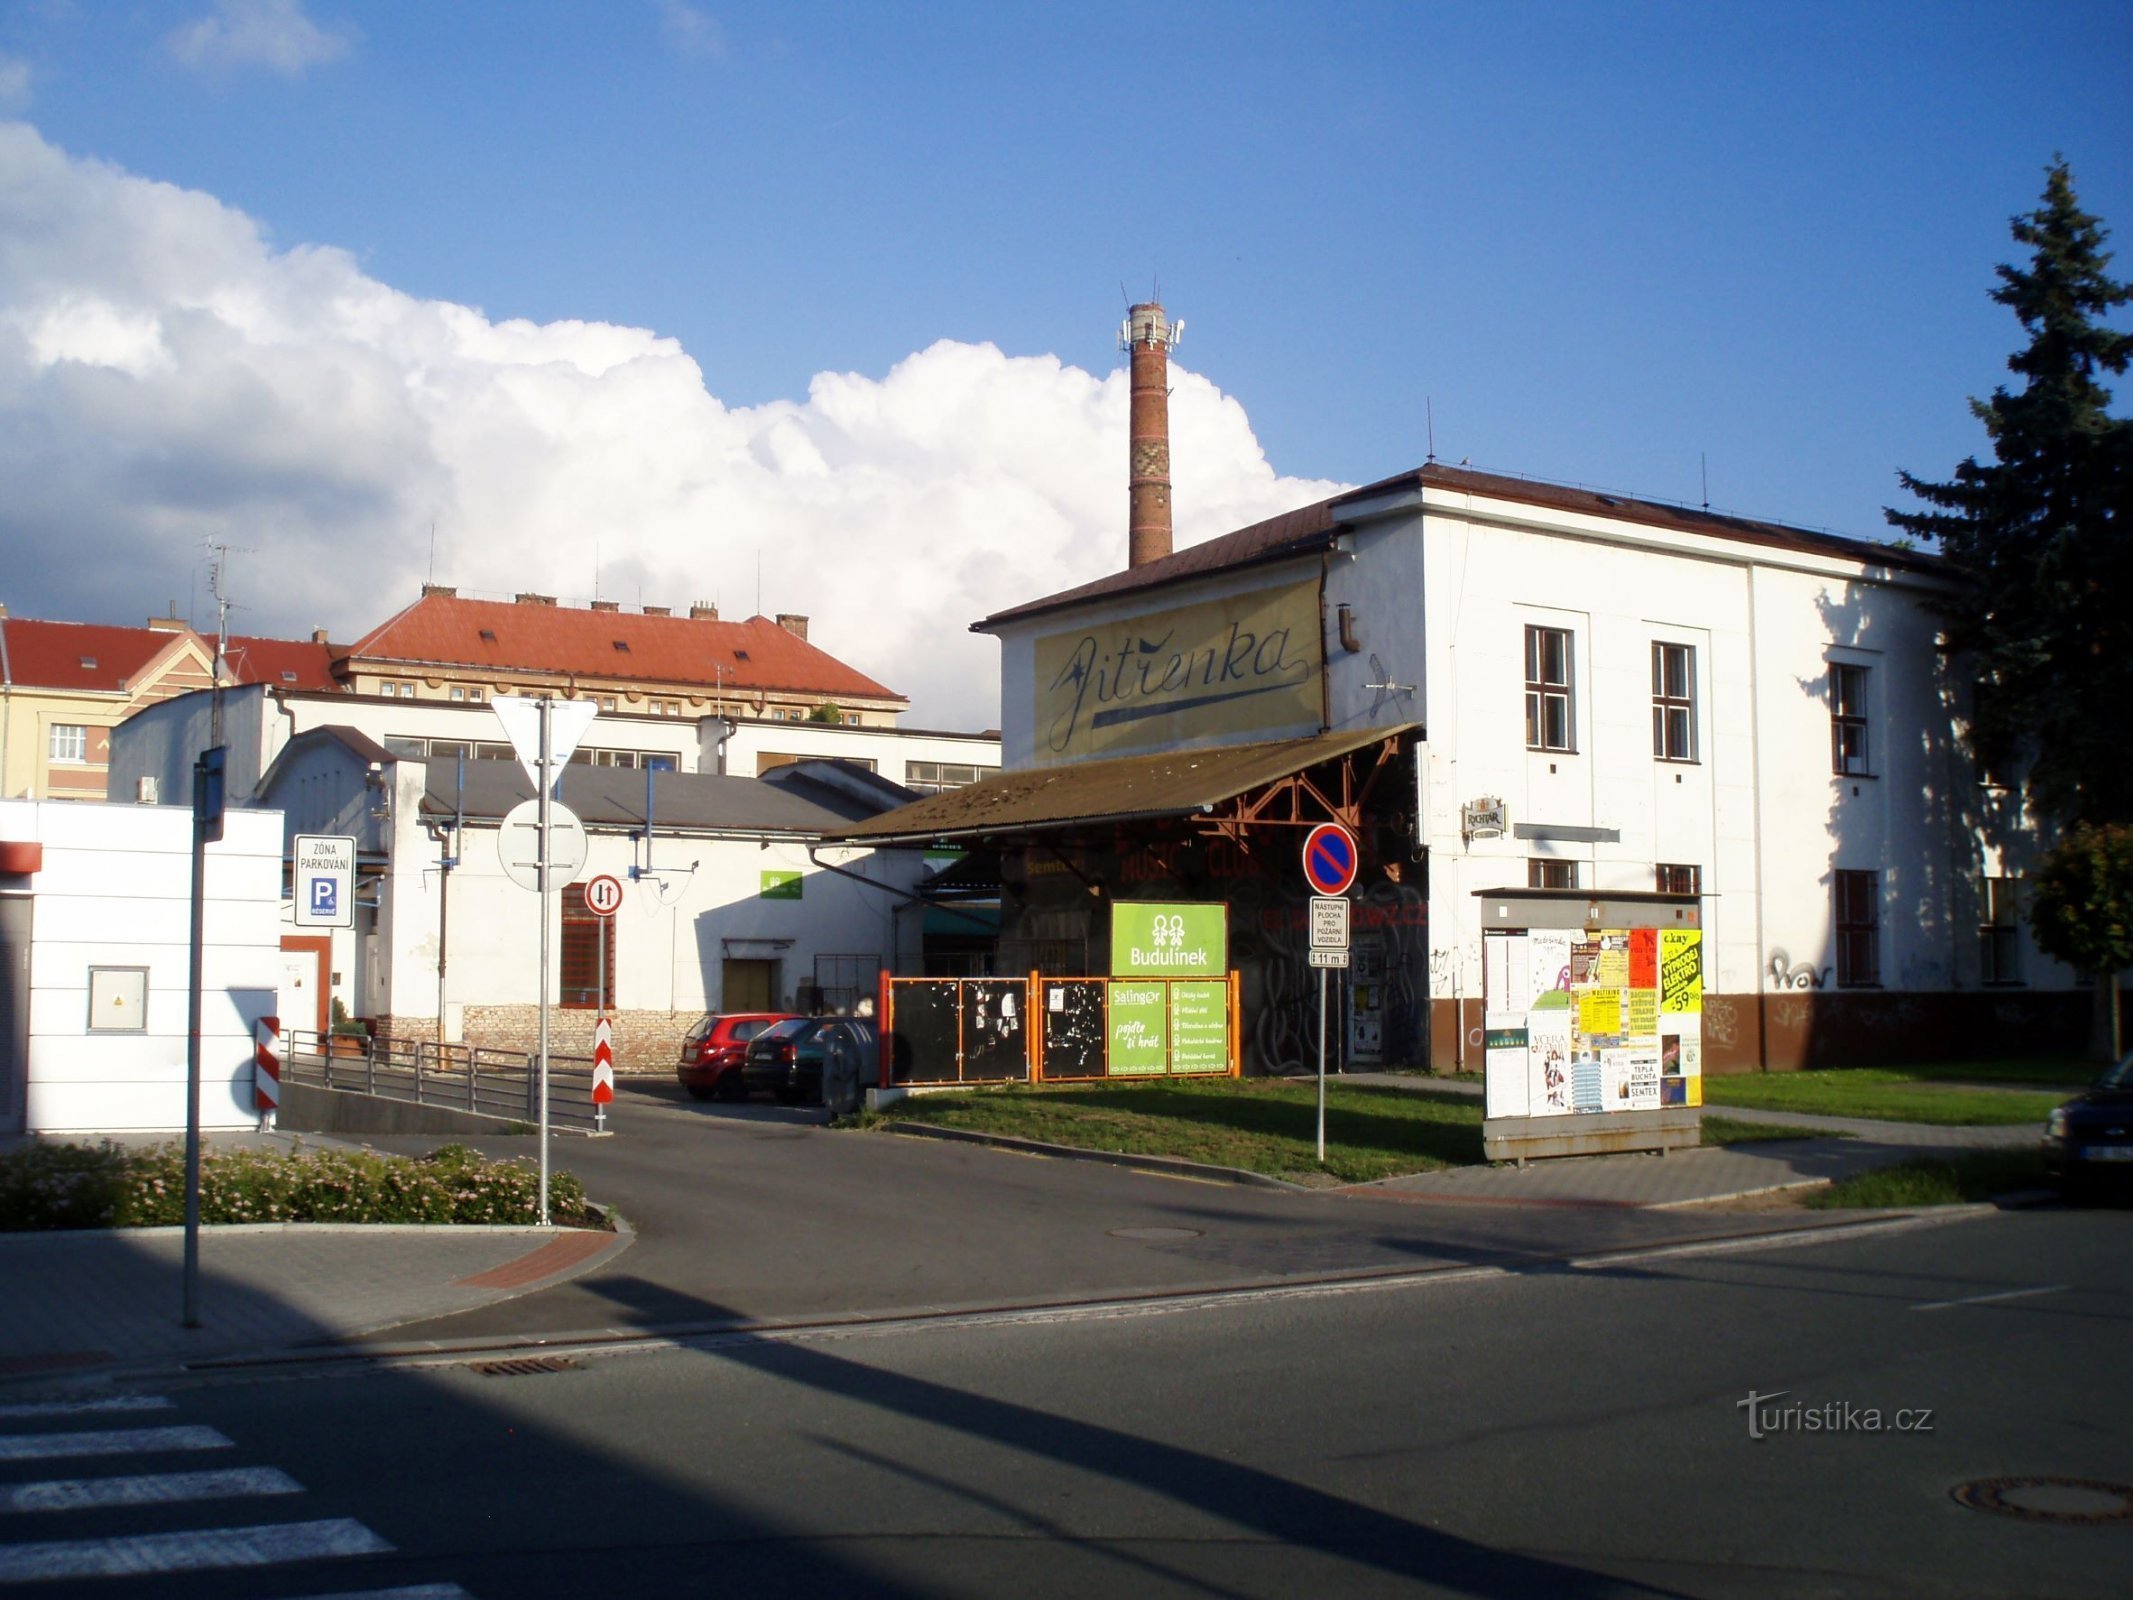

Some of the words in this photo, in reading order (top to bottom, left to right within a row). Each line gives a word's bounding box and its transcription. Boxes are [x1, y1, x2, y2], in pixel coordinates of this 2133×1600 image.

[1048, 622, 1312, 753] Jitřenka
[313, 842, 337, 855] ZÓNA
[300, 857, 349, 870] PARKOVÁNÍ
[315, 881, 333, 906] P
[1315, 903, 1345, 911] NÁSTUPNÍ
[1131, 946, 1208, 966] Budulínek
[1320, 953, 1328, 964] 11
[1331, 956, 1340, 964] m
[1662, 947, 1699, 976] VÝPRODEJ
[1663, 961, 1698, 990] ELEKTRO
[1631, 1073, 1657, 1081] BUCHTA
[1631, 1087, 1658, 1098] SEMTEX
